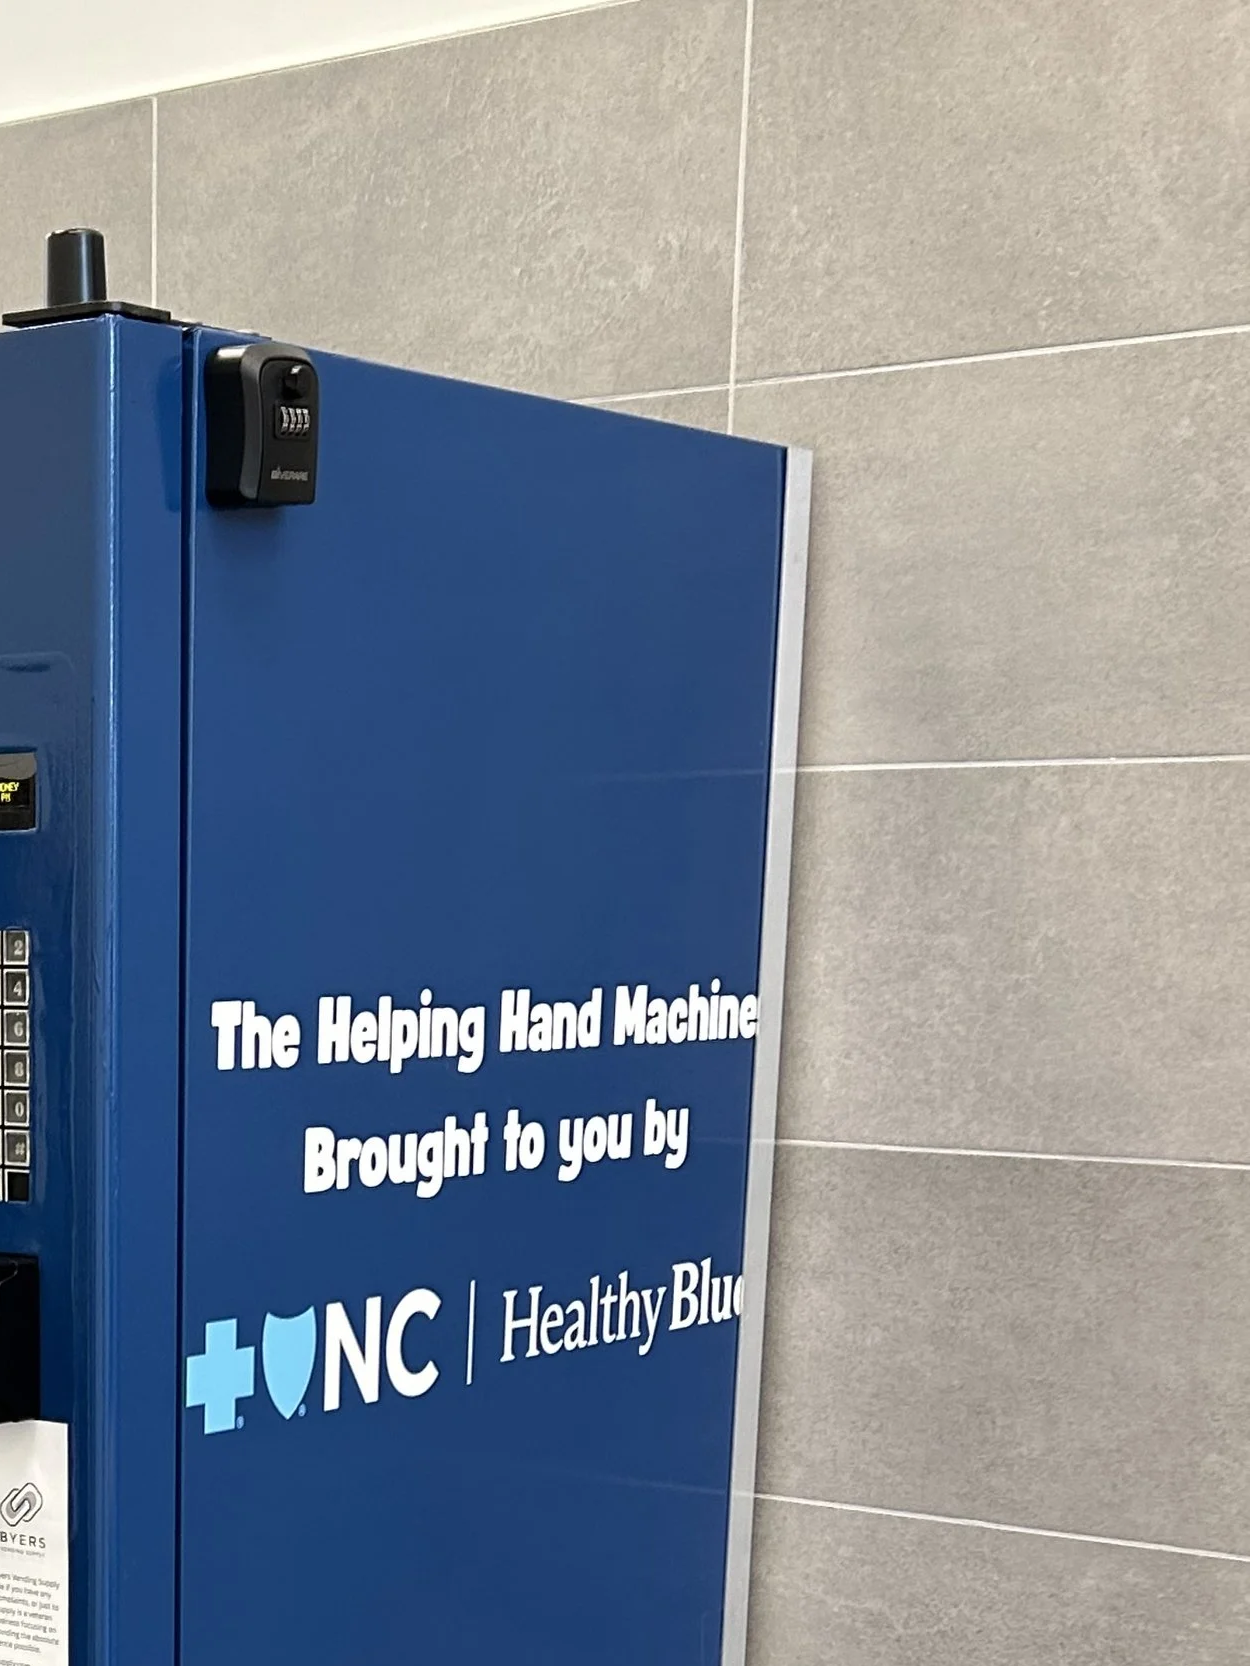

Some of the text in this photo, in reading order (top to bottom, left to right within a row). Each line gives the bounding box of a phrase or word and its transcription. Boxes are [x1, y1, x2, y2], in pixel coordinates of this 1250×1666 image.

[14, 940, 23, 955] 2
[13, 981, 22, 996] 4
[14, 1021, 23, 1037] 6
[211, 978, 758, 1074] The Helping Hand Machine
[15, 1062, 24, 1077] 8
[15, 1102, 24, 1117] 0
[302, 1098, 689, 1198] Brought to you by
[323, 1288, 441, 1412] NC
[500, 1269, 667, 1363] Healthy
[0, 1531, 46, 1549] BYERS
